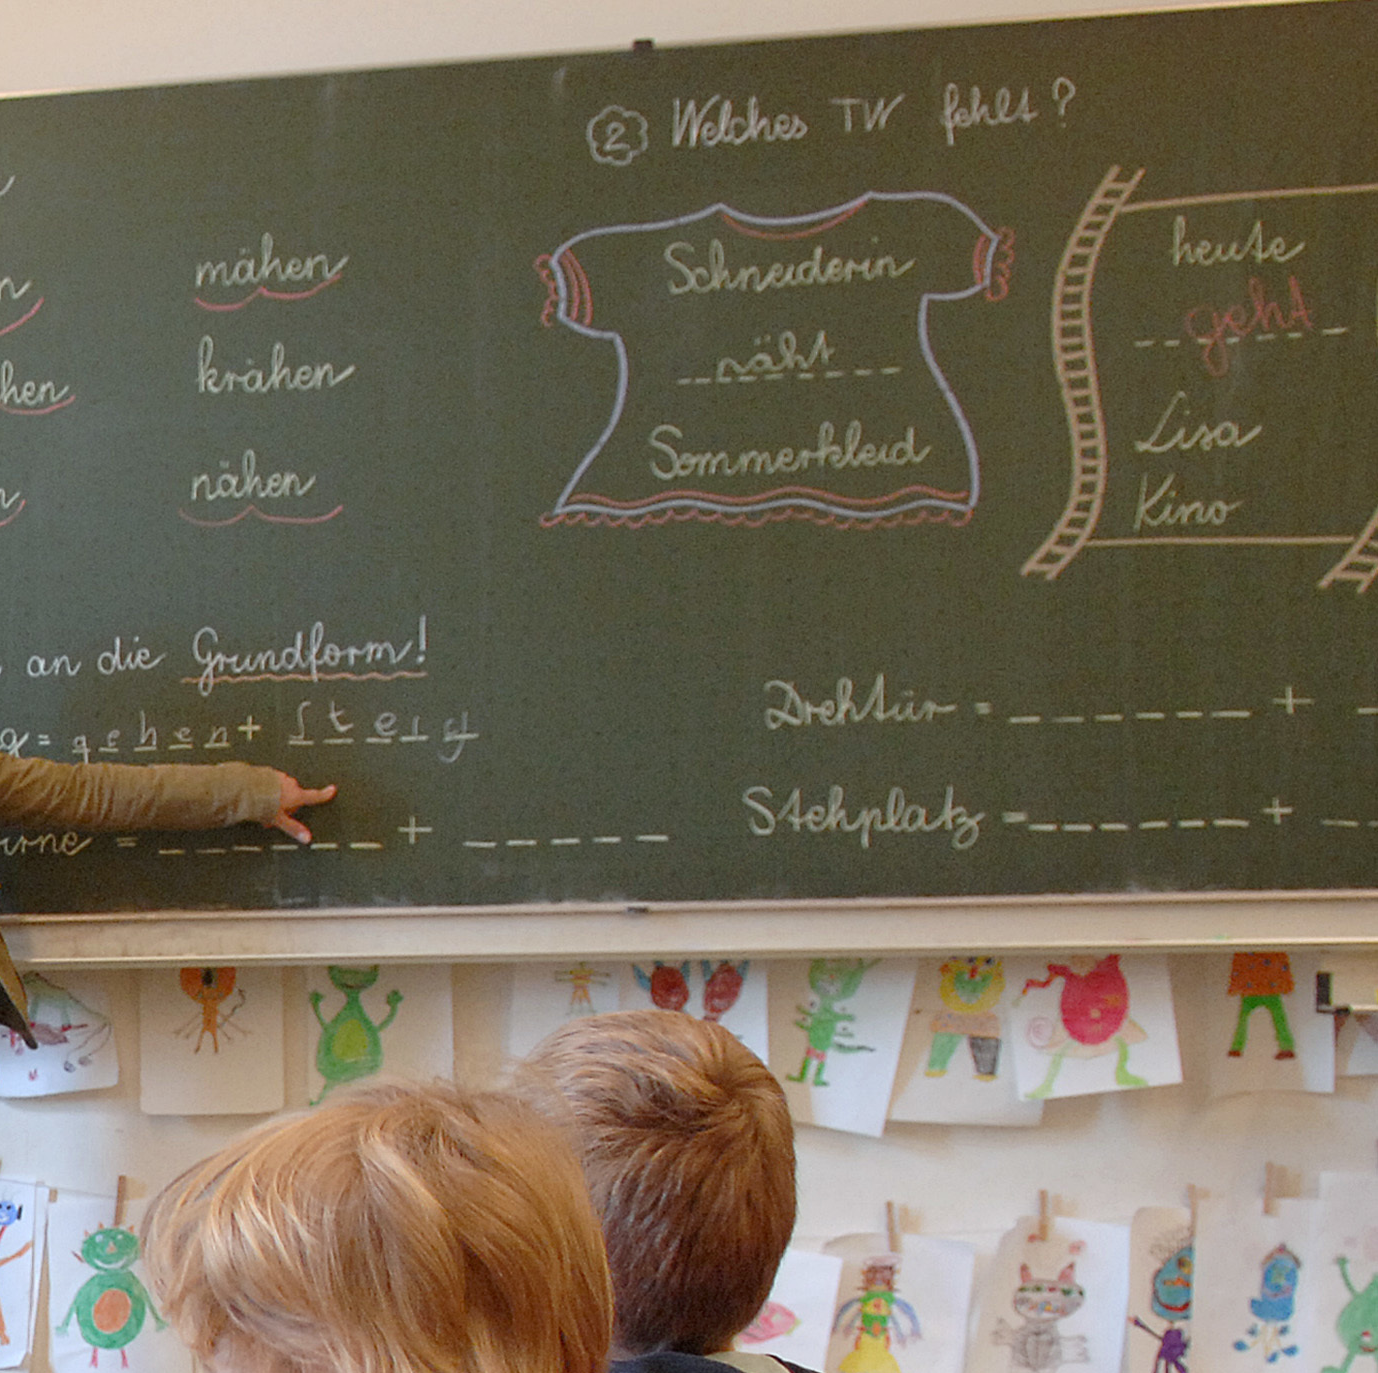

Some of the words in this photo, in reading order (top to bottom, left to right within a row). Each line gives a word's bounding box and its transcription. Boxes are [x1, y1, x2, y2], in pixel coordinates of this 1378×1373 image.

[672, 96, 809, 149] Welches
[832, 94, 905, 132] TW
[194, 233, 350, 286] mähen
[663, 238, 915, 297] Schneiderin
[1172, 214, 1307, 266] heute
[715, 328, 837, 383] näht
[1185, 275, 1313, 379] geht
[197, 335, 356, 394] krähen
[646, 421, 934, 481] Sommerkleid
[1135, 390, 1262, 457] Lisa
[191, 449, 317, 501] nähen
[1133, 474, 1243, 534] Kino
[26, 651, 80, 680] an
[97, 636, 165, 676] die
[192, 615, 428, 696] Grundform!
[763, 672, 957, 731] Drehtür
[744, 785, 986, 849] Stehplatz
